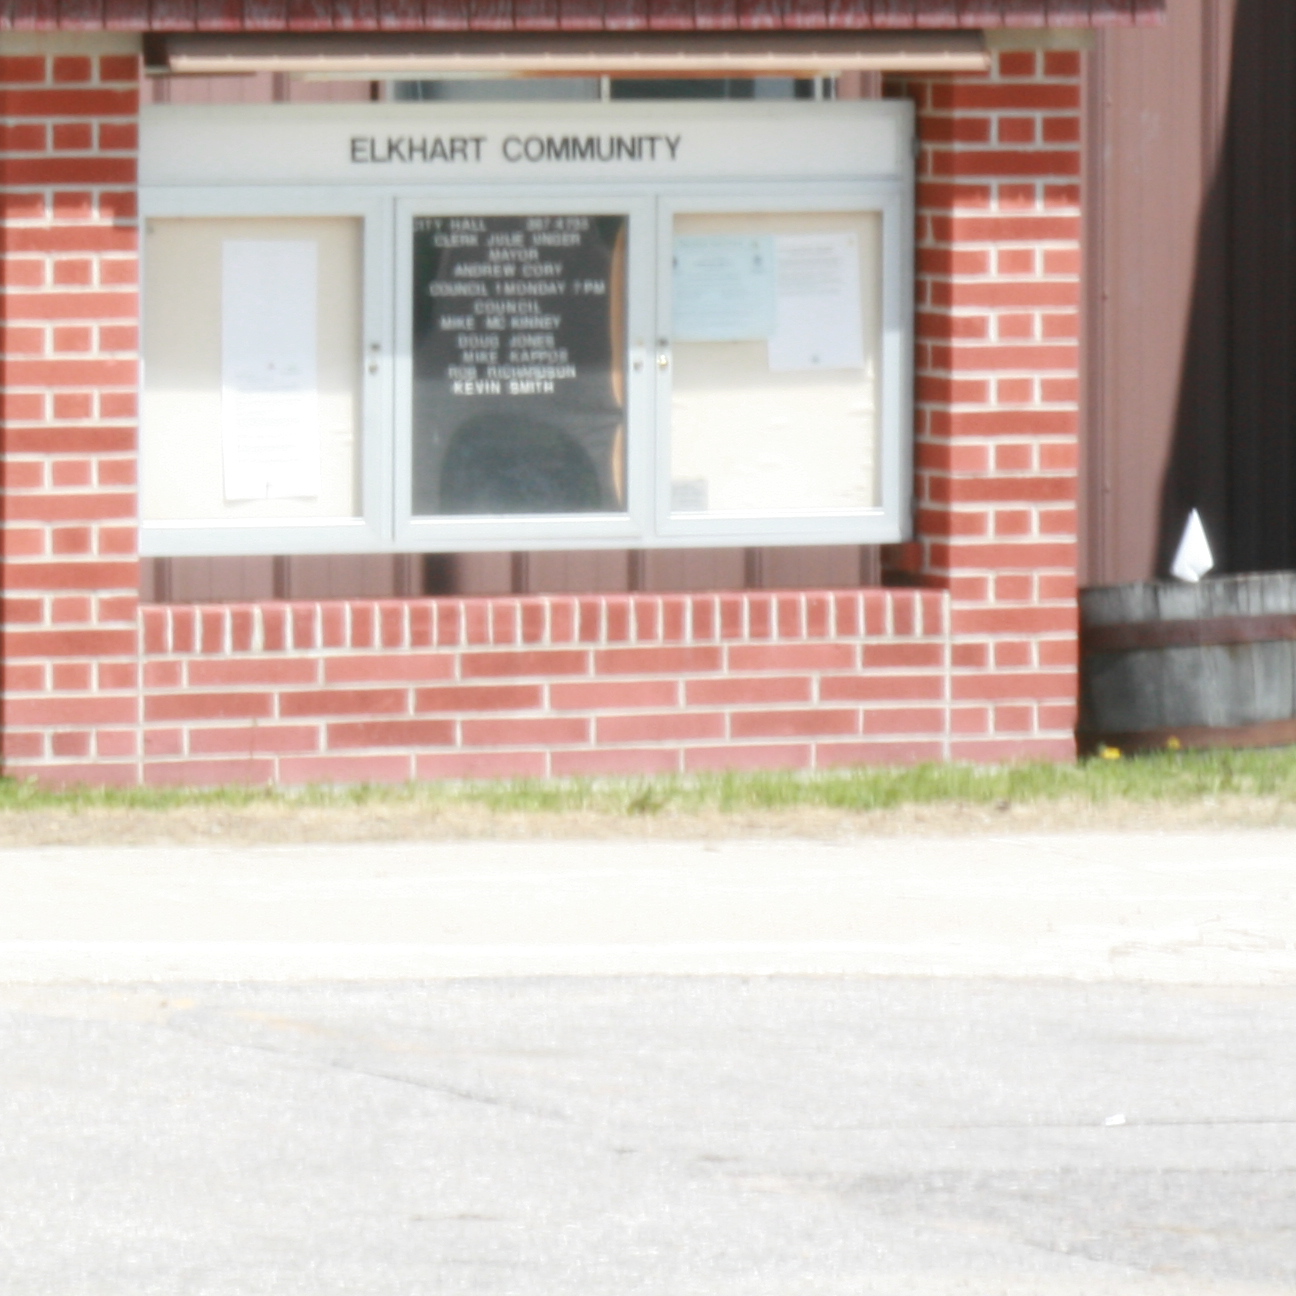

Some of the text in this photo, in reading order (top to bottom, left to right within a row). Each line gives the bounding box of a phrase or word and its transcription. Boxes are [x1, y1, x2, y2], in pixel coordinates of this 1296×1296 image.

[350, 135, 681, 163] ELKHART COMMUNITY
[450, 217, 487, 232] HALL
[434, 233, 479, 248] CLERK
[489, 249, 539, 262] MAYOR
[455, 263, 515, 278] ANDREW
[429, 281, 488, 297] COUNCIL
[474, 300, 541, 315] COUNCIL
[440, 315, 475, 331] MIKE
[458, 334, 500, 349] DOUG
[462, 350, 499, 364] MIKE
[453, 380, 555, 395] KEVIN SMITH
